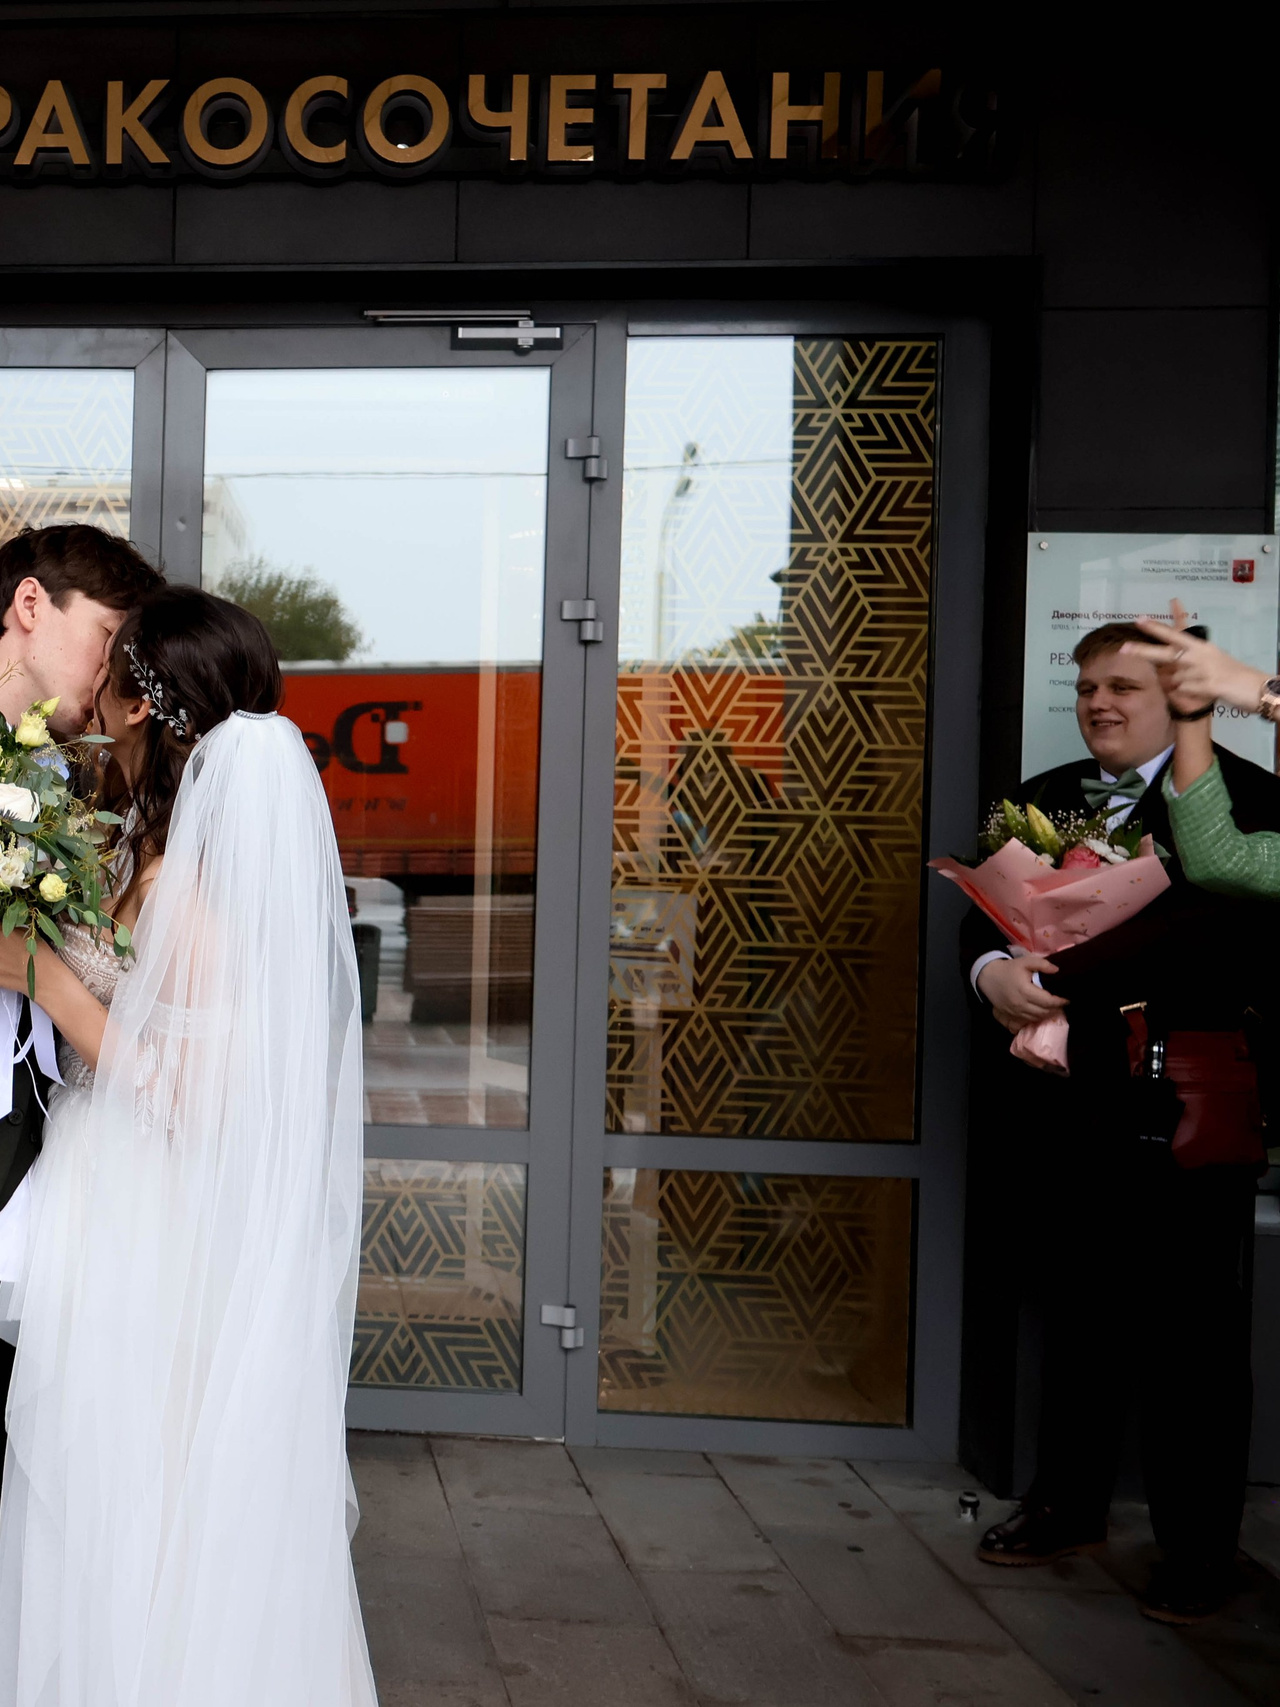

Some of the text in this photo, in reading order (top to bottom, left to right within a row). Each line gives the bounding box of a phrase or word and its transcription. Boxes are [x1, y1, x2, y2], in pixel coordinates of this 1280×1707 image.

[1051, 610, 1090, 621] Дворец
[1191, 612, 1198, 620] 4
[1050, 652, 1075, 665] РЕЖ
[1049, 679, 1076, 687] ПОНЕДЕ
